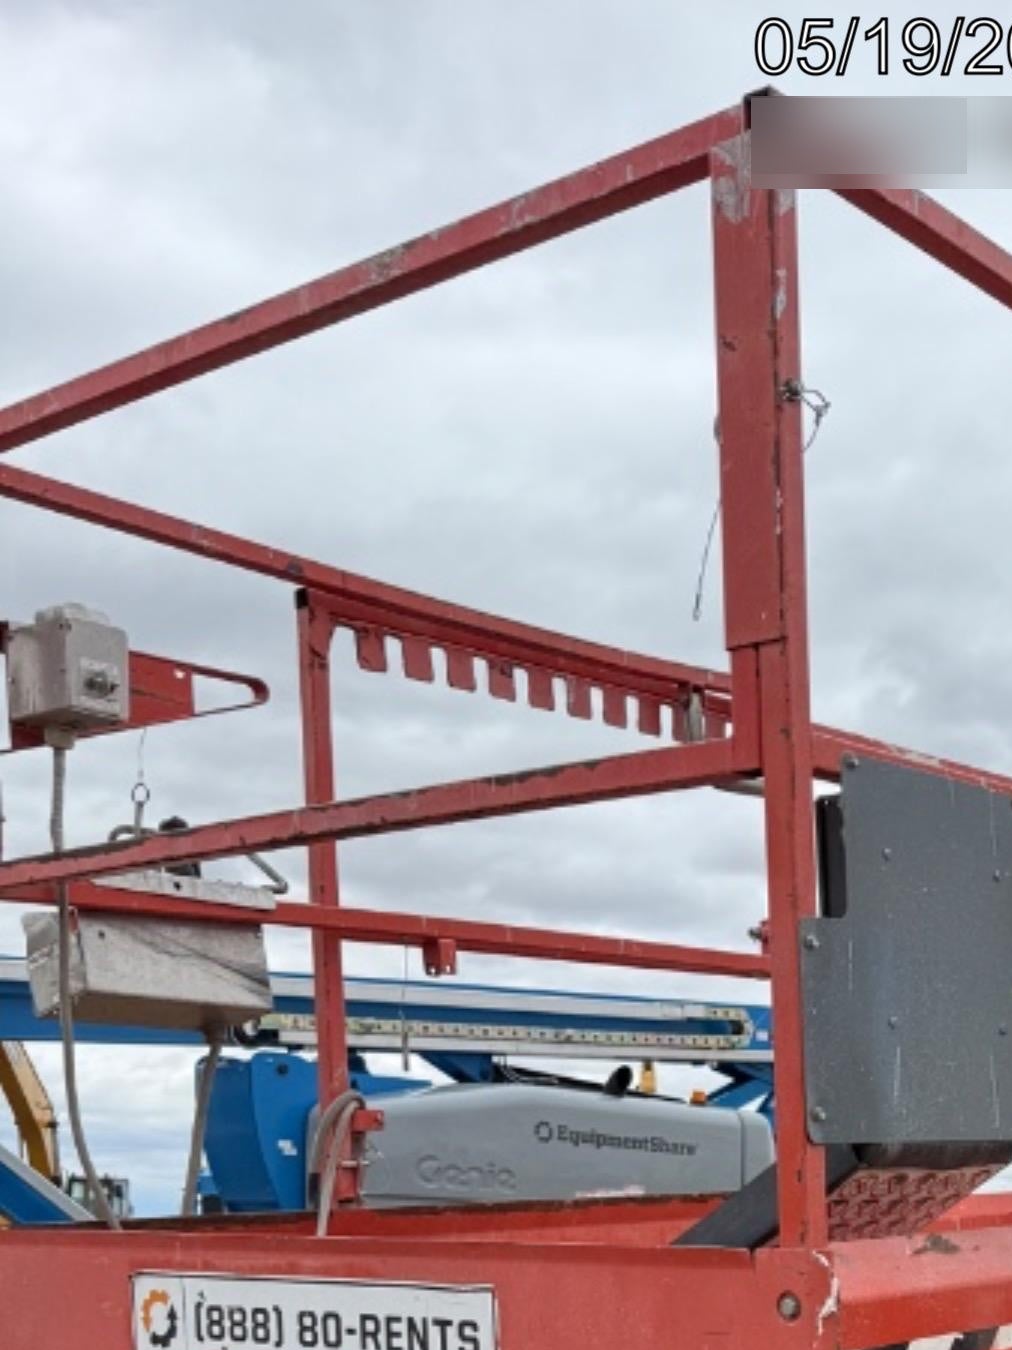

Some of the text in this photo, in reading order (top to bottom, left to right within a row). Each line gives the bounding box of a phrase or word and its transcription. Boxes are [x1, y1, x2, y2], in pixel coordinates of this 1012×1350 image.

[557, 1123, 697, 1156] EquipmentShare
[416, 1154, 517, 1189] Genie
[194, 1302, 284, 1348] (888)
